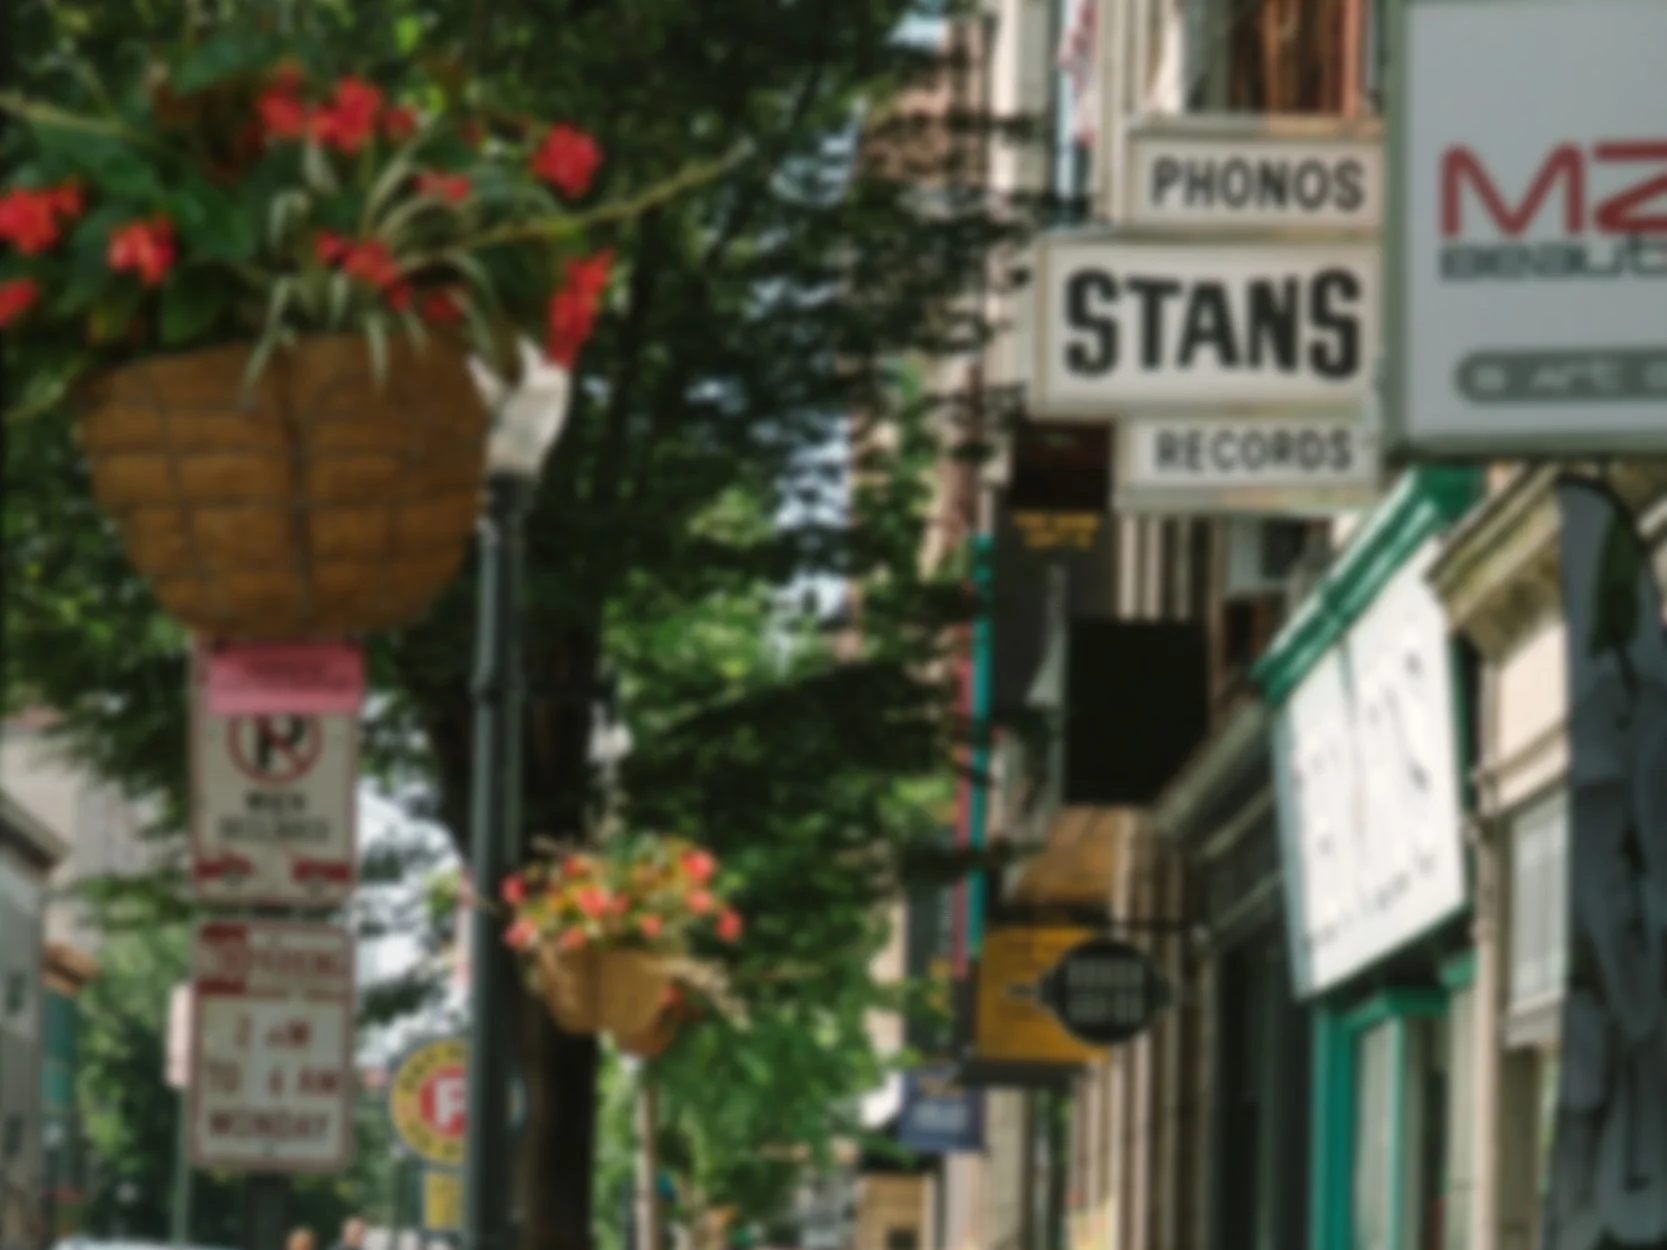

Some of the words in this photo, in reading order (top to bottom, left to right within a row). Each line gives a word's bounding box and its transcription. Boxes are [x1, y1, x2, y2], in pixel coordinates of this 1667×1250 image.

[1151, 156, 1366, 212] PHONOS
[1063, 267, 1362, 381] STANS
[1154, 429, 1354, 473] RECORDS
[208, 1109, 330, 1140] MONDAY
